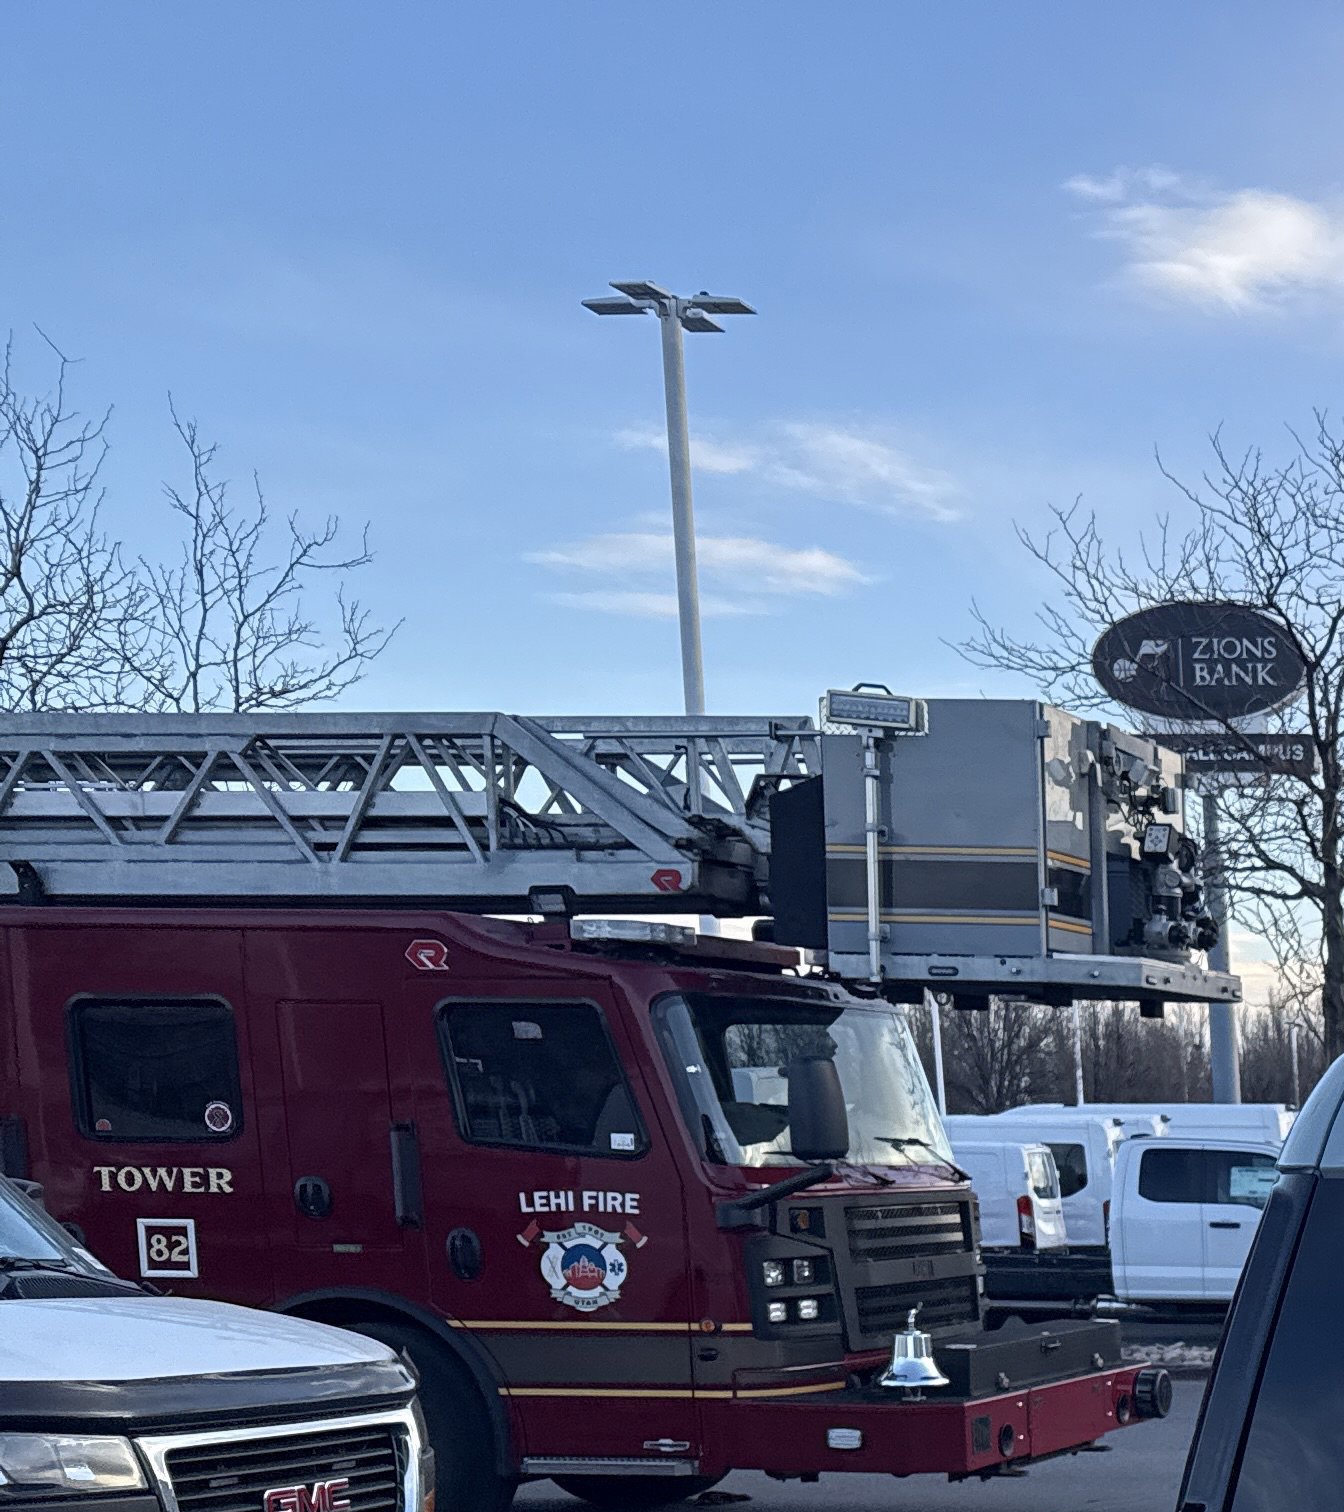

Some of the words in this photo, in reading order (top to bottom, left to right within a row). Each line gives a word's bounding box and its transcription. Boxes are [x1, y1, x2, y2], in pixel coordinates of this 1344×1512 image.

[1192, 637, 1278, 660] ZIONS
[1192, 662, 1280, 687] BANK
[93, 1166, 234, 1193] TOWER
[518, 1190, 575, 1213] LEHI
[582, 1190, 641, 1214] FIRE
[149, 1234, 189, 1262] 82
